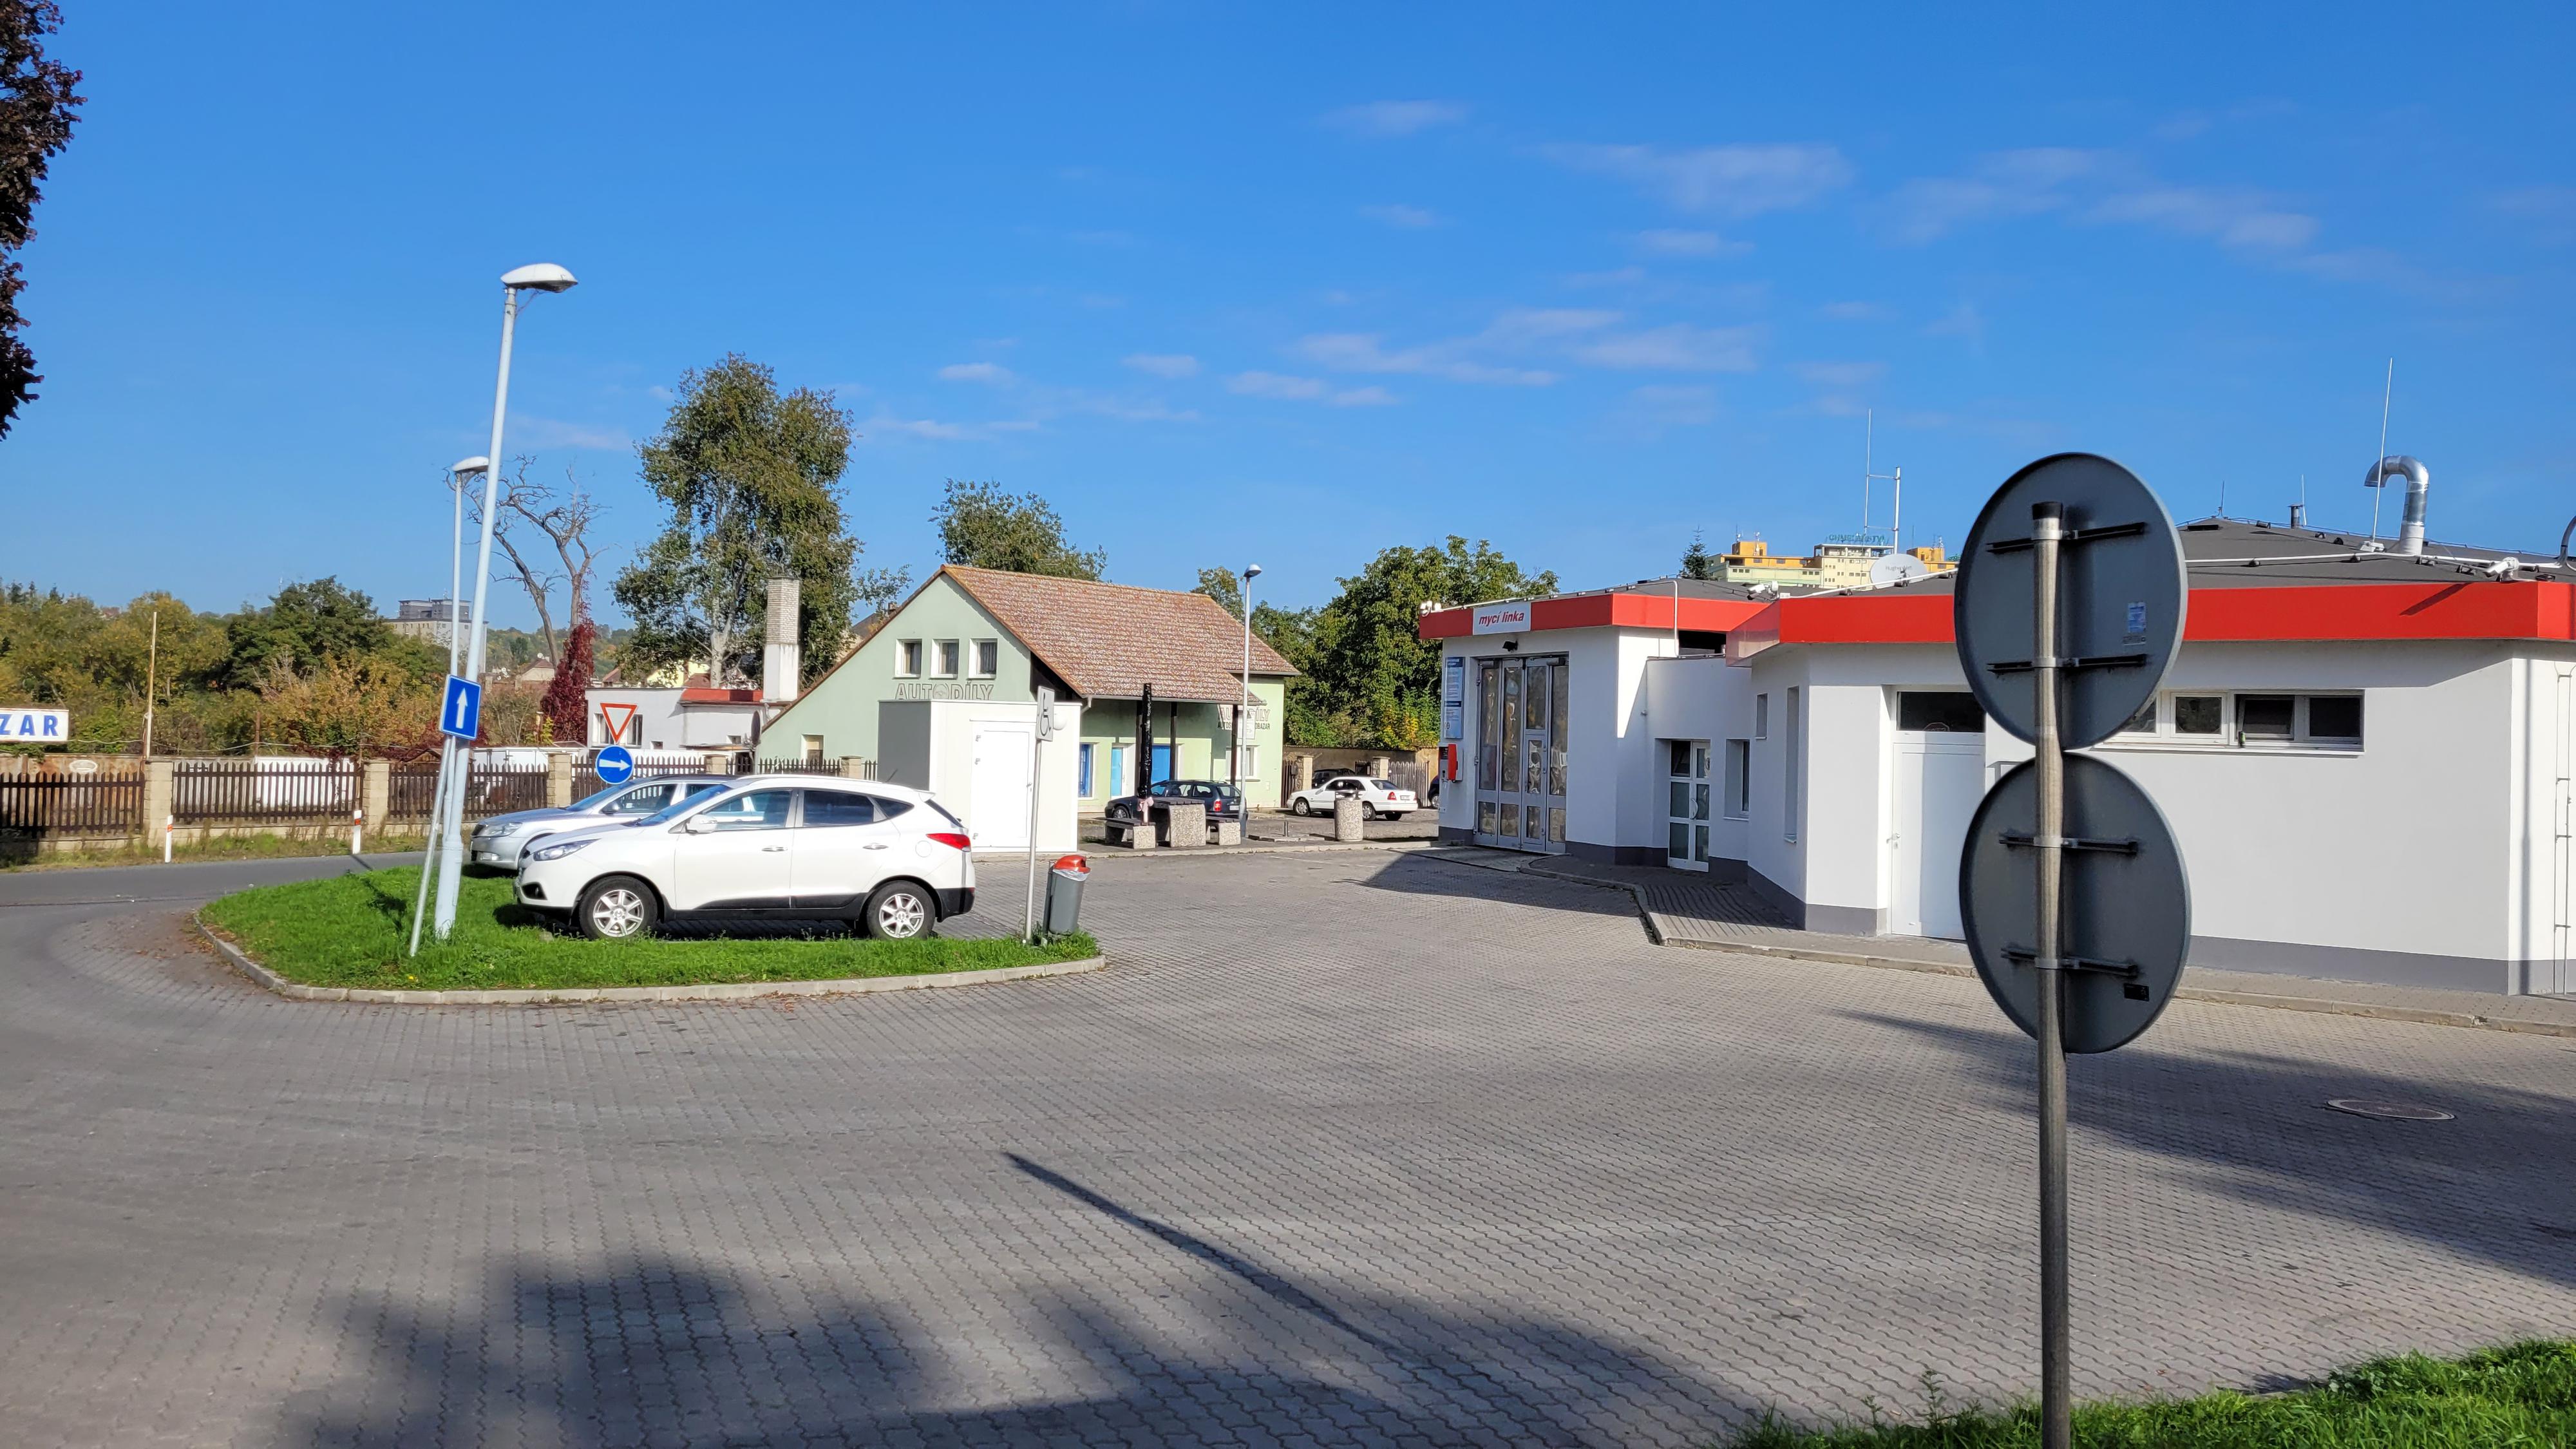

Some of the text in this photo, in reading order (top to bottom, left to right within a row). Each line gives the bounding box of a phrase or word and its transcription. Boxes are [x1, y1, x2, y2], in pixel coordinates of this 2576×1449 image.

[1479, 610, 1524, 627] mycí linka
[895, 680, 994, 700] AUTODÍLY
[0, 714, 59, 737] ZAR
